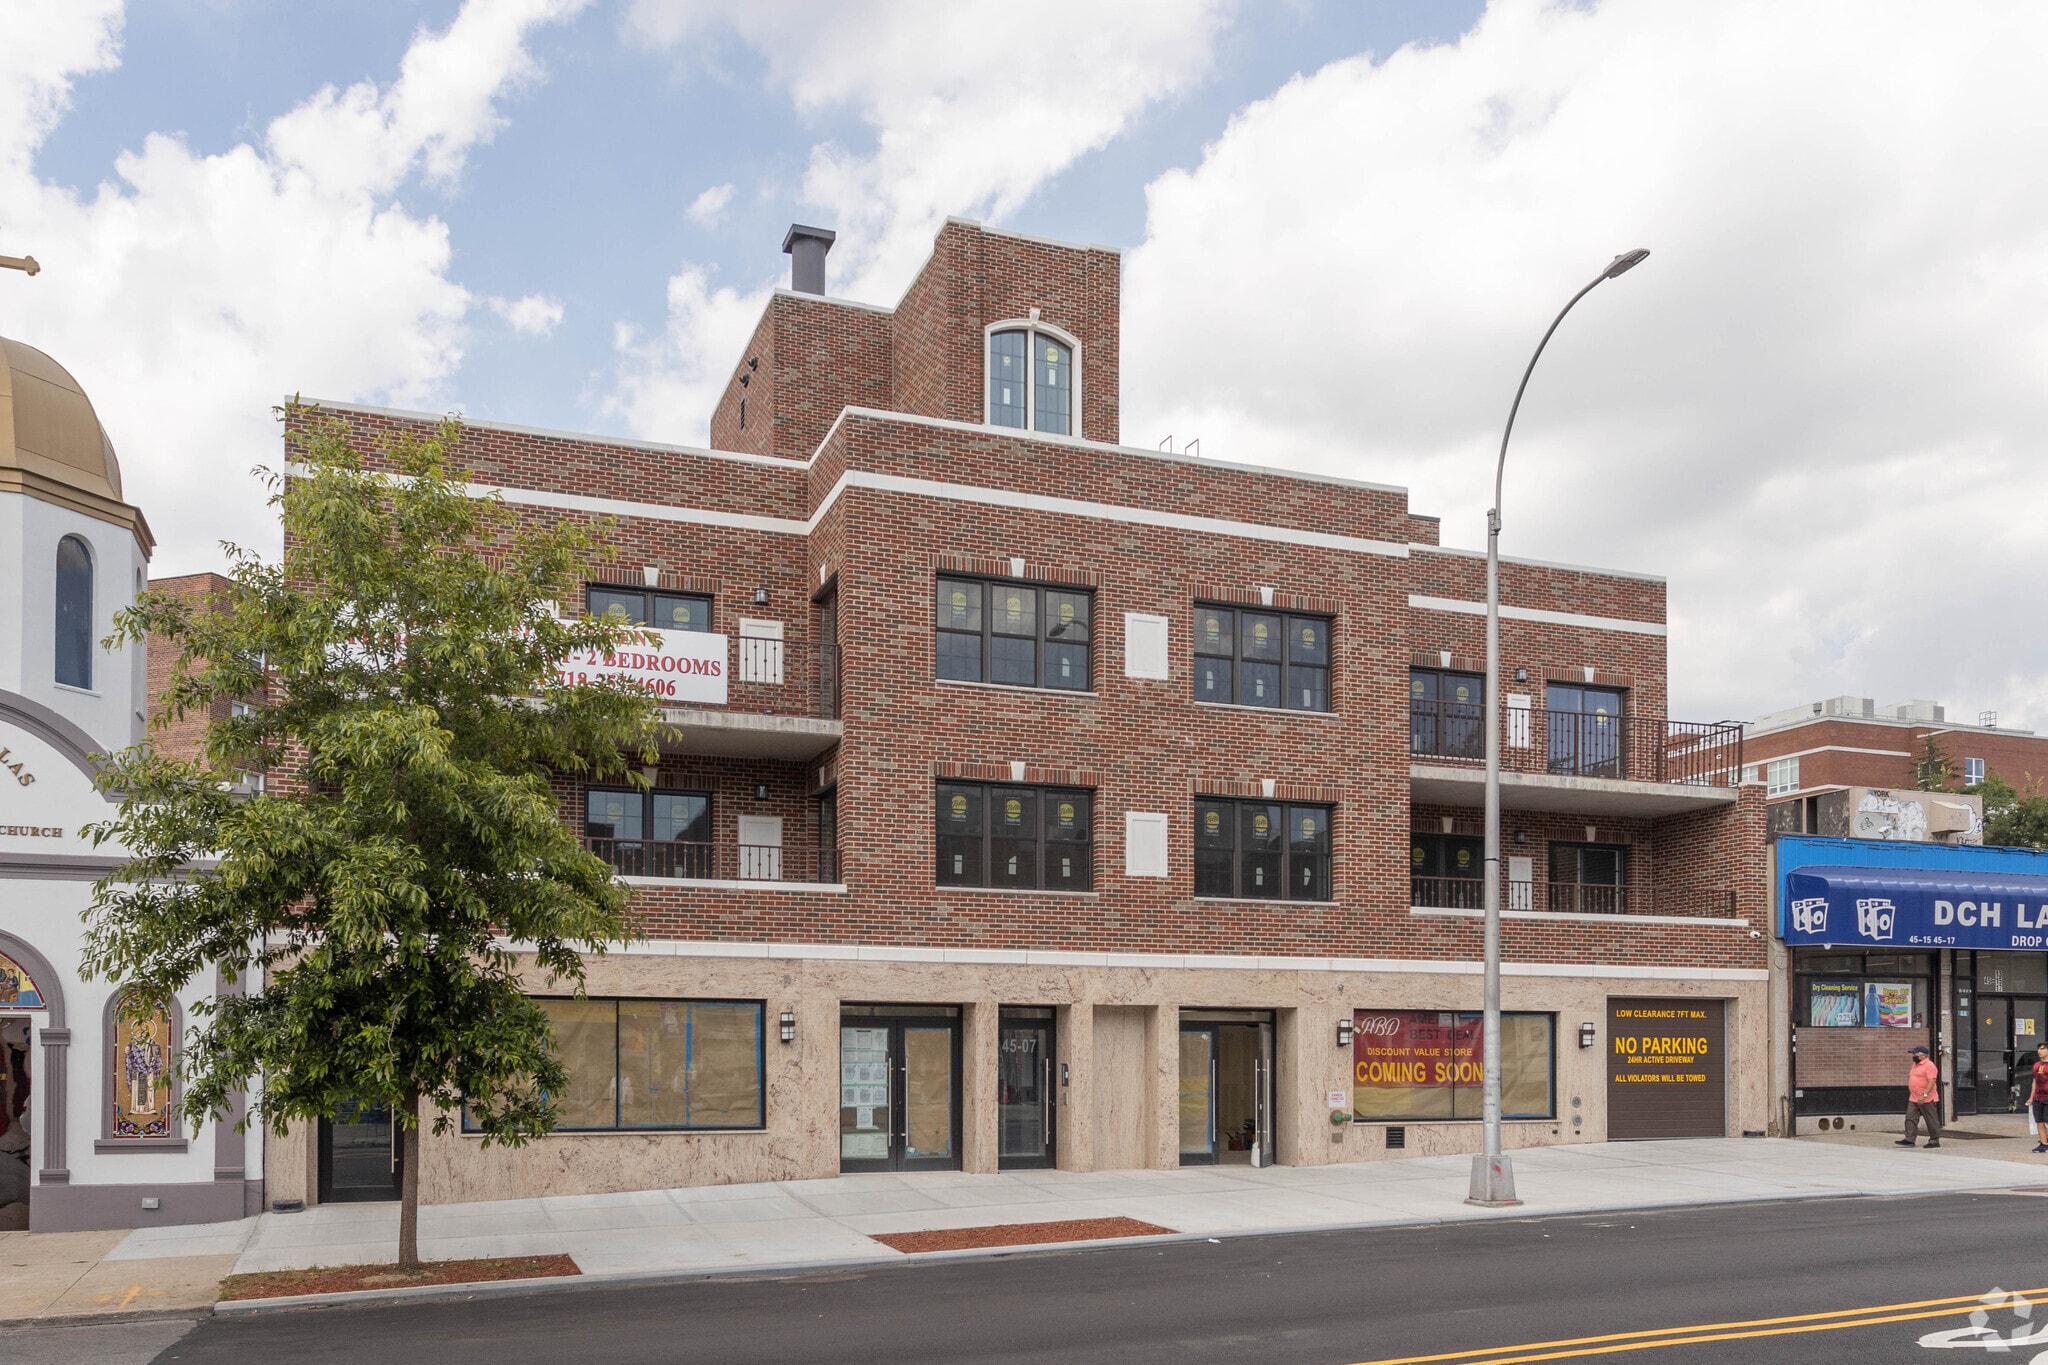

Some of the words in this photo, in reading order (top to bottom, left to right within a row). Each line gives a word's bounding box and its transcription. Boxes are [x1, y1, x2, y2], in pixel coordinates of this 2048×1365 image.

[606, 626, 661, 649] ENT
[587, 649, 597, 666] 2
[603, 651, 721, 677] BEDROOMS
[1873, 789, 1890, 798] YORK
[0, 825, 63, 838] CHURCH
[1934, 900, 2001, 927] DCH
[1909, 935, 1932, 944] 45-15
[1933, 936, 1955, 945] 45-17
[2011, 935, 2042, 947] DROP
[1812, 983, 1820, 992] Dry
[1821, 983, 1840, 992] Cleaning
[1841, 983, 1858, 991] Service
[1883, 987, 1898, 996] Drop
[1884, 996, 1909, 1004] Service
[1616, 1009, 1632, 1018] LOW
[1633, 1009, 1675, 1018] CLEARANCE
[1677, 1010, 1689, 1018] 7FT
[1690, 1010, 1707, 1019] MAX.
[1409, 1029, 1440, 1040] BEST
[1002, 1038, 1037, 1053] 45-07
[1615, 1037, 1637, 1054] NO
[1642, 1037, 1708, 1054] PARKING
[1367, 1047, 1410, 1056] DISCOUNT
[1414, 1048, 1440, 1056] VALUE
[1444, 1048, 1473, 1056] STORE
[1627, 1056, 1642, 1064] 24HR
[1643, 1056, 1664, 1064] ACTIVE
[1665, 1056, 1694, 1064] DRIVEWAY
[1356, 1061, 1426, 1082] COMING
[1435, 1061, 1484, 1082] SOON
[1615, 1074, 1627, 1082] ALL
[1627, 1074, 1660, 1082] VIOLATORS
[1661, 1074, 1675, 1082] WILL
[1676, 1074, 1685, 1082] BE
[1685, 1074, 1706, 1082] TOWED
